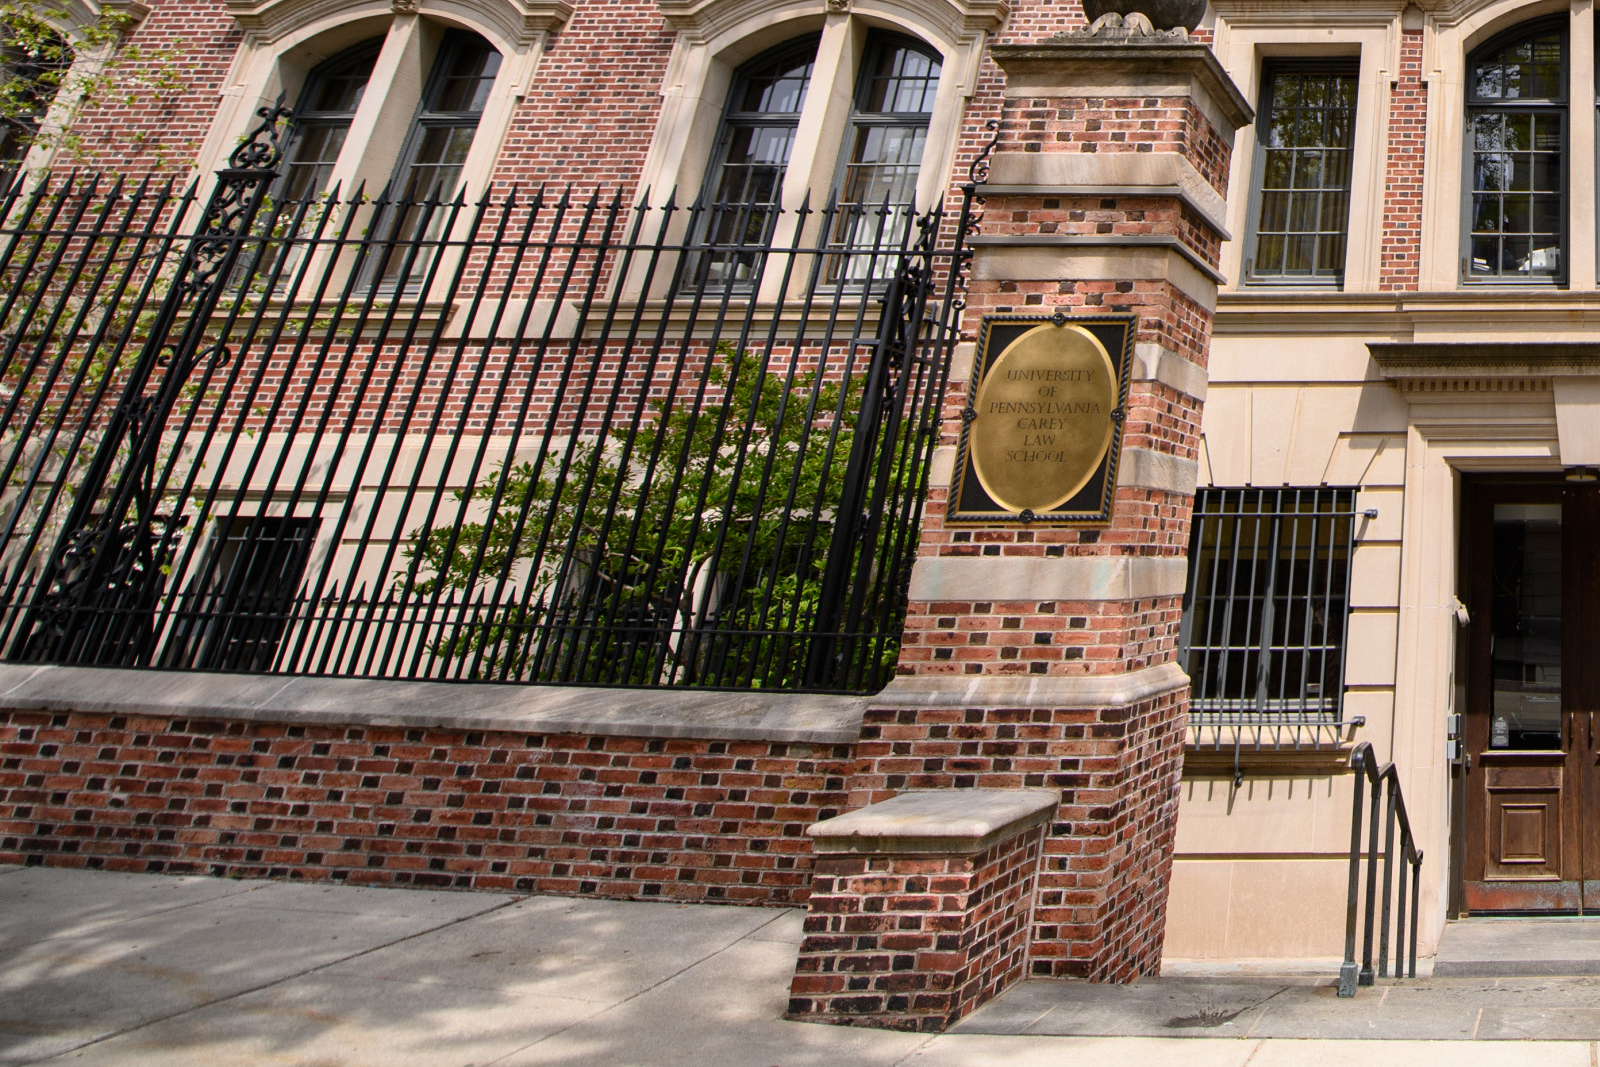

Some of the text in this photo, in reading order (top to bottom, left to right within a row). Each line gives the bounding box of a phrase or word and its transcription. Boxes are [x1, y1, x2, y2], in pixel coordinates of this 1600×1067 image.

[1006, 369, 1095, 382] UNIVERSITY
[1038, 386, 1058, 398] OF
[989, 401, 1100, 415] PENNSYLVANIA
[1017, 418, 1068, 431] CAREY
[1023, 434, 1056, 447] LAW
[1005, 450, 1068, 463] SCHOOL
